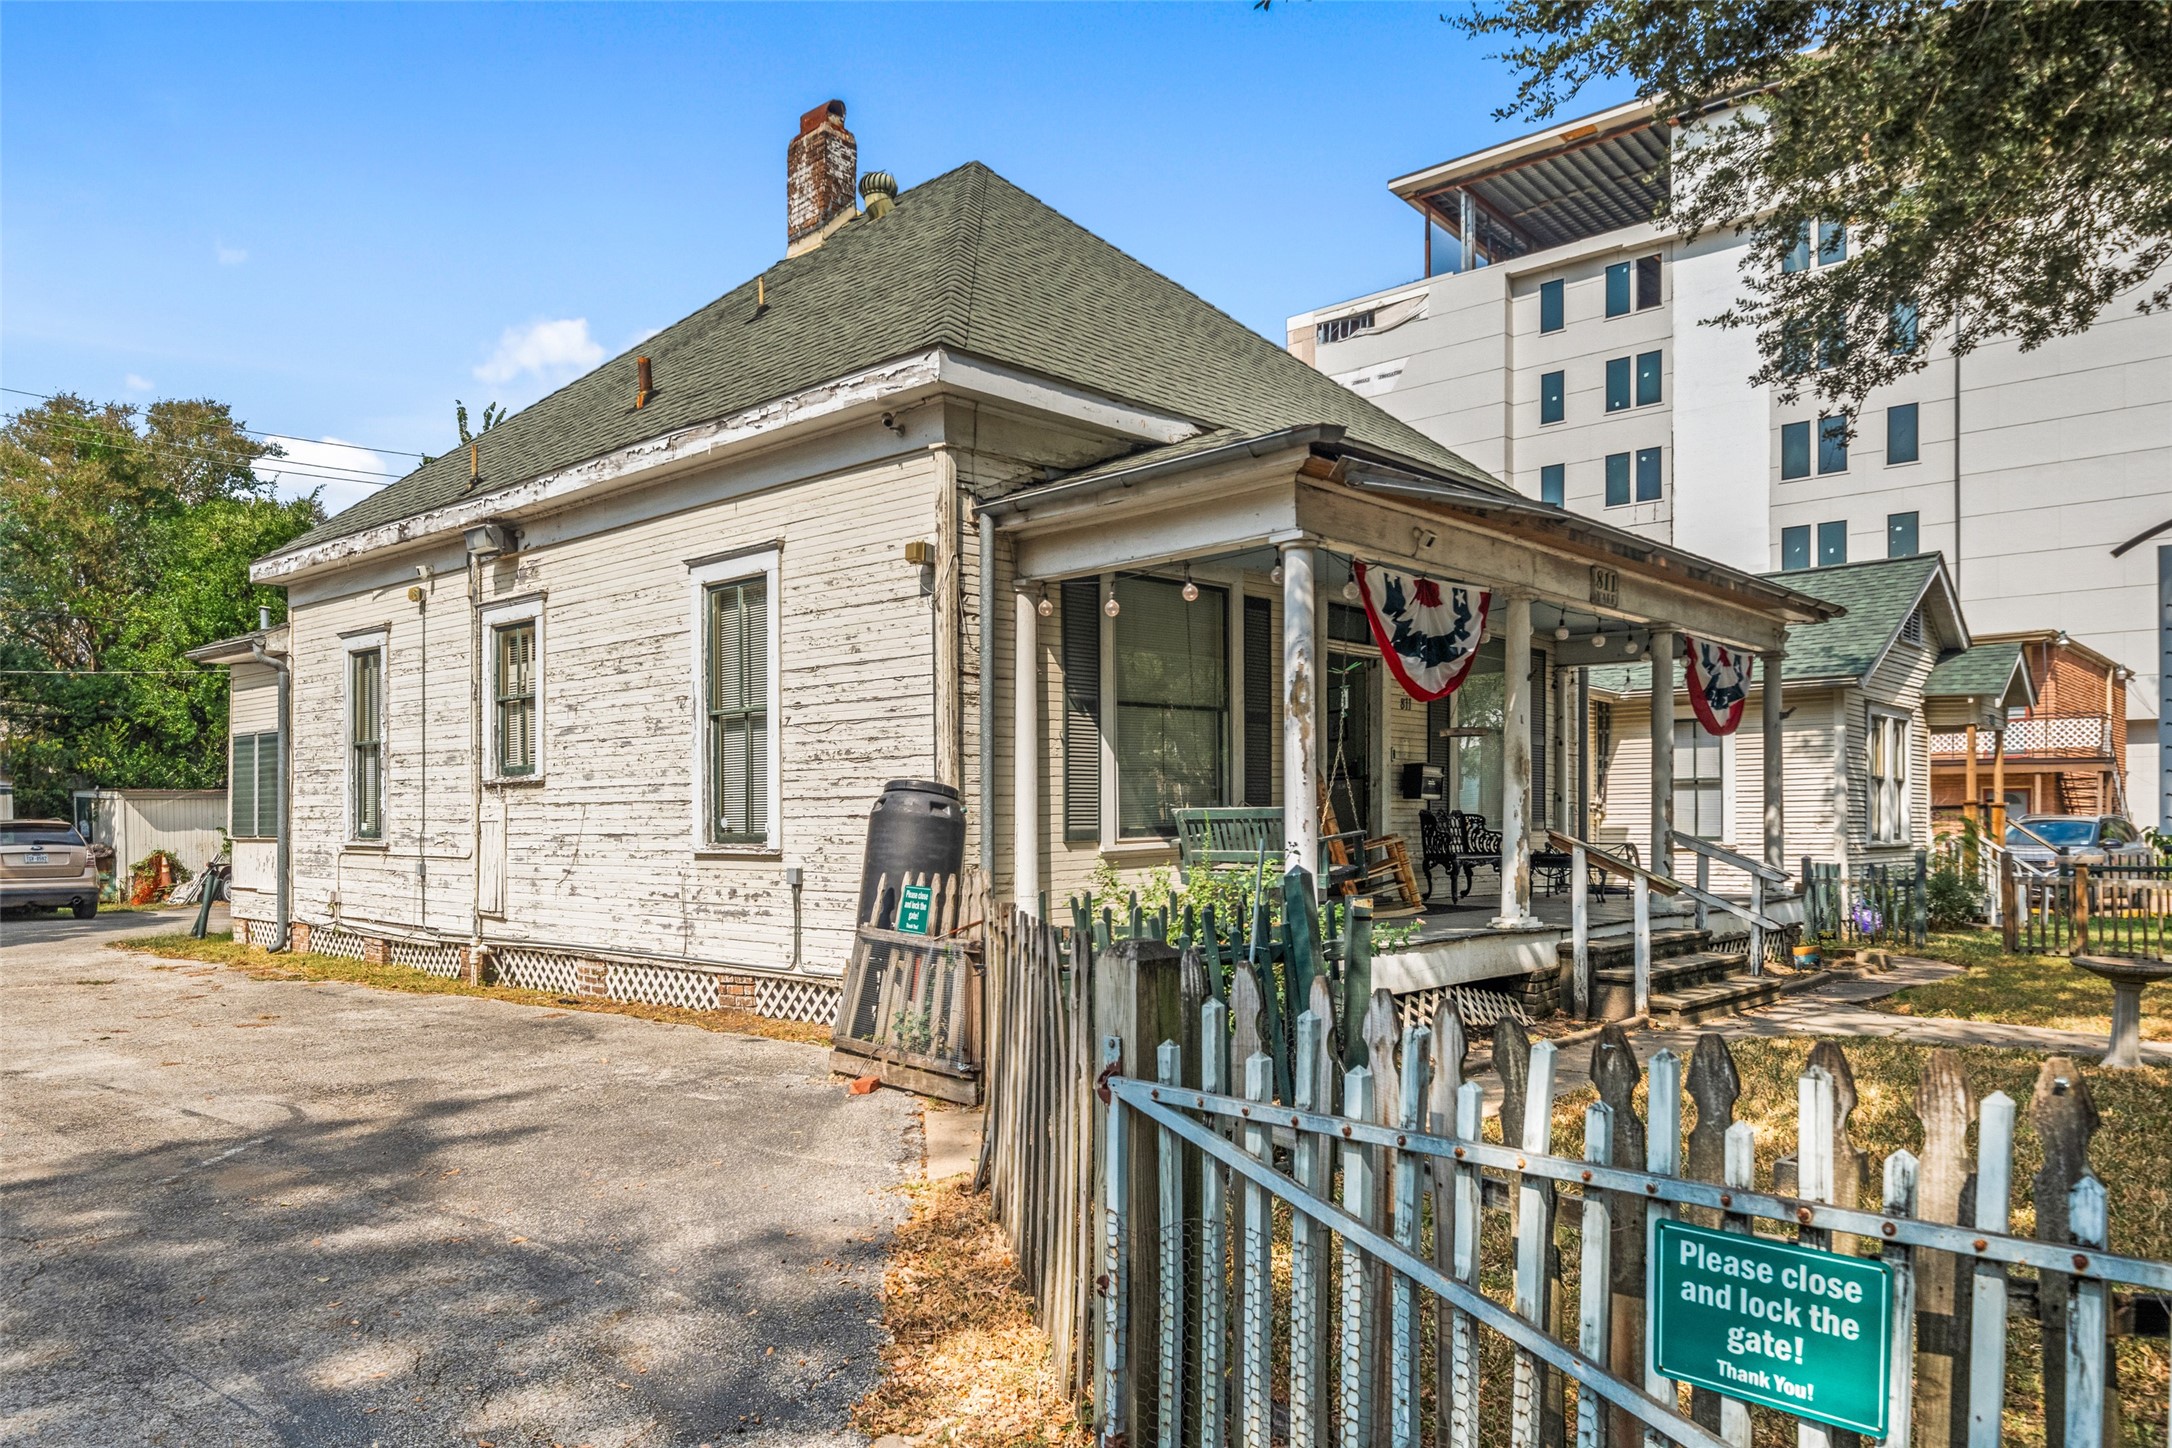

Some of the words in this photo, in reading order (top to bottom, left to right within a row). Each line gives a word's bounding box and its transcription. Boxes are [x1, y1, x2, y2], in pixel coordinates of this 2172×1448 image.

[1596, 570, 1616, 593] 811
[1400, 698, 1411, 710] 811
[1679, 1239, 1774, 1285] Please
[1781, 1264, 1863, 1304] close
[1680, 1280, 1731, 1310] and
[1740, 1287, 1802, 1328] lock
[1808, 1304, 1860, 1341] the
[1726, 1326, 1804, 1365] gate!
[1716, 1358, 1770, 1389] Thank
[1773, 1373, 1814, 1401] You!
